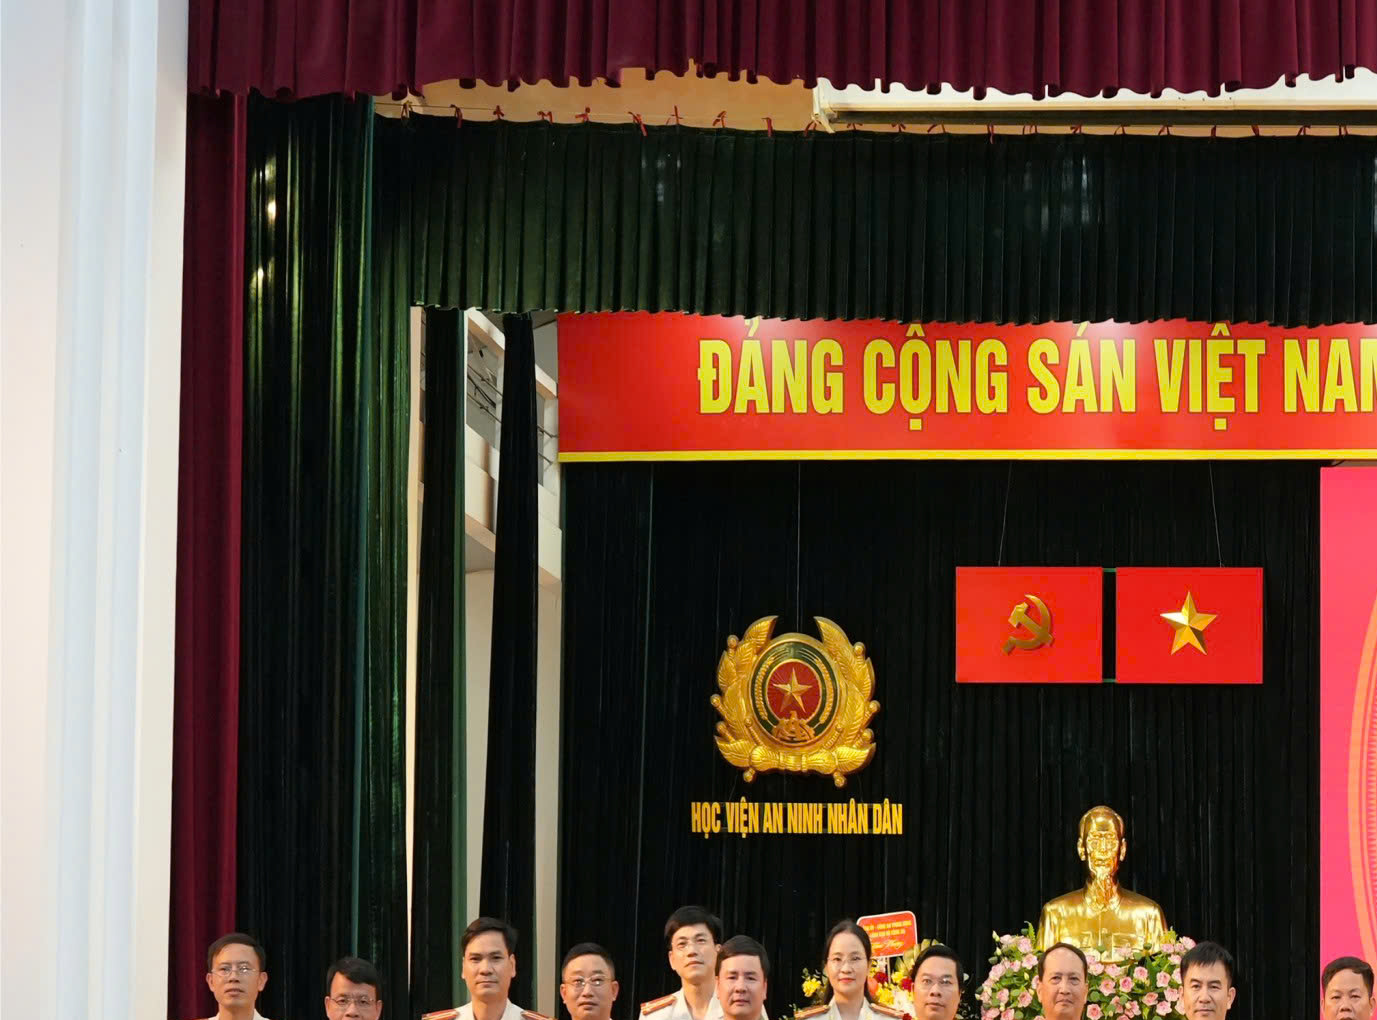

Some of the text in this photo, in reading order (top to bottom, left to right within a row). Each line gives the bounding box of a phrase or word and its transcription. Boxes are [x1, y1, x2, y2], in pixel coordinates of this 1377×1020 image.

[863, 324, 1008, 431] CỘNG
[1153, 322, 1266, 431] VIỆT
[691, 796, 903, 839] HỌC VIỆN AN NINH NHÂN DÂN
